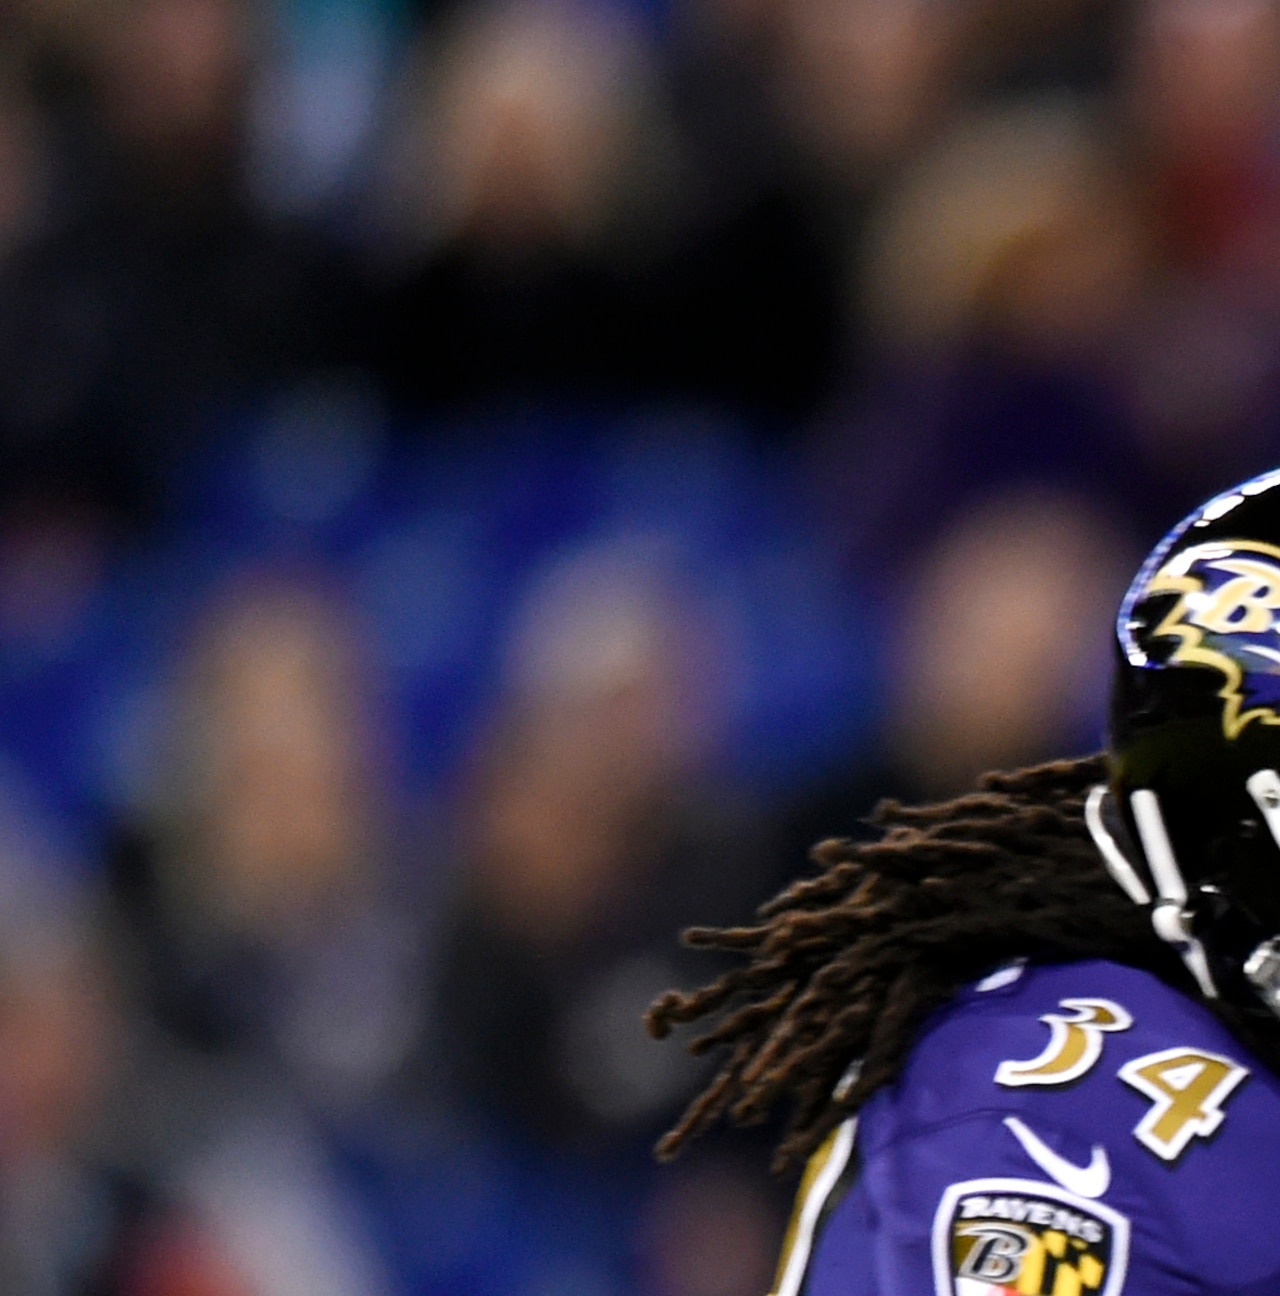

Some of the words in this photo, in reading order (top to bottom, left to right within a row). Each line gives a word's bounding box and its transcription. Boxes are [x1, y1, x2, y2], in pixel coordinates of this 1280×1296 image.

[994, 998, 1250, 1161] 34
[959, 1197, 1103, 1243] RAVENS
[955, 1222, 1028, 1284] B
